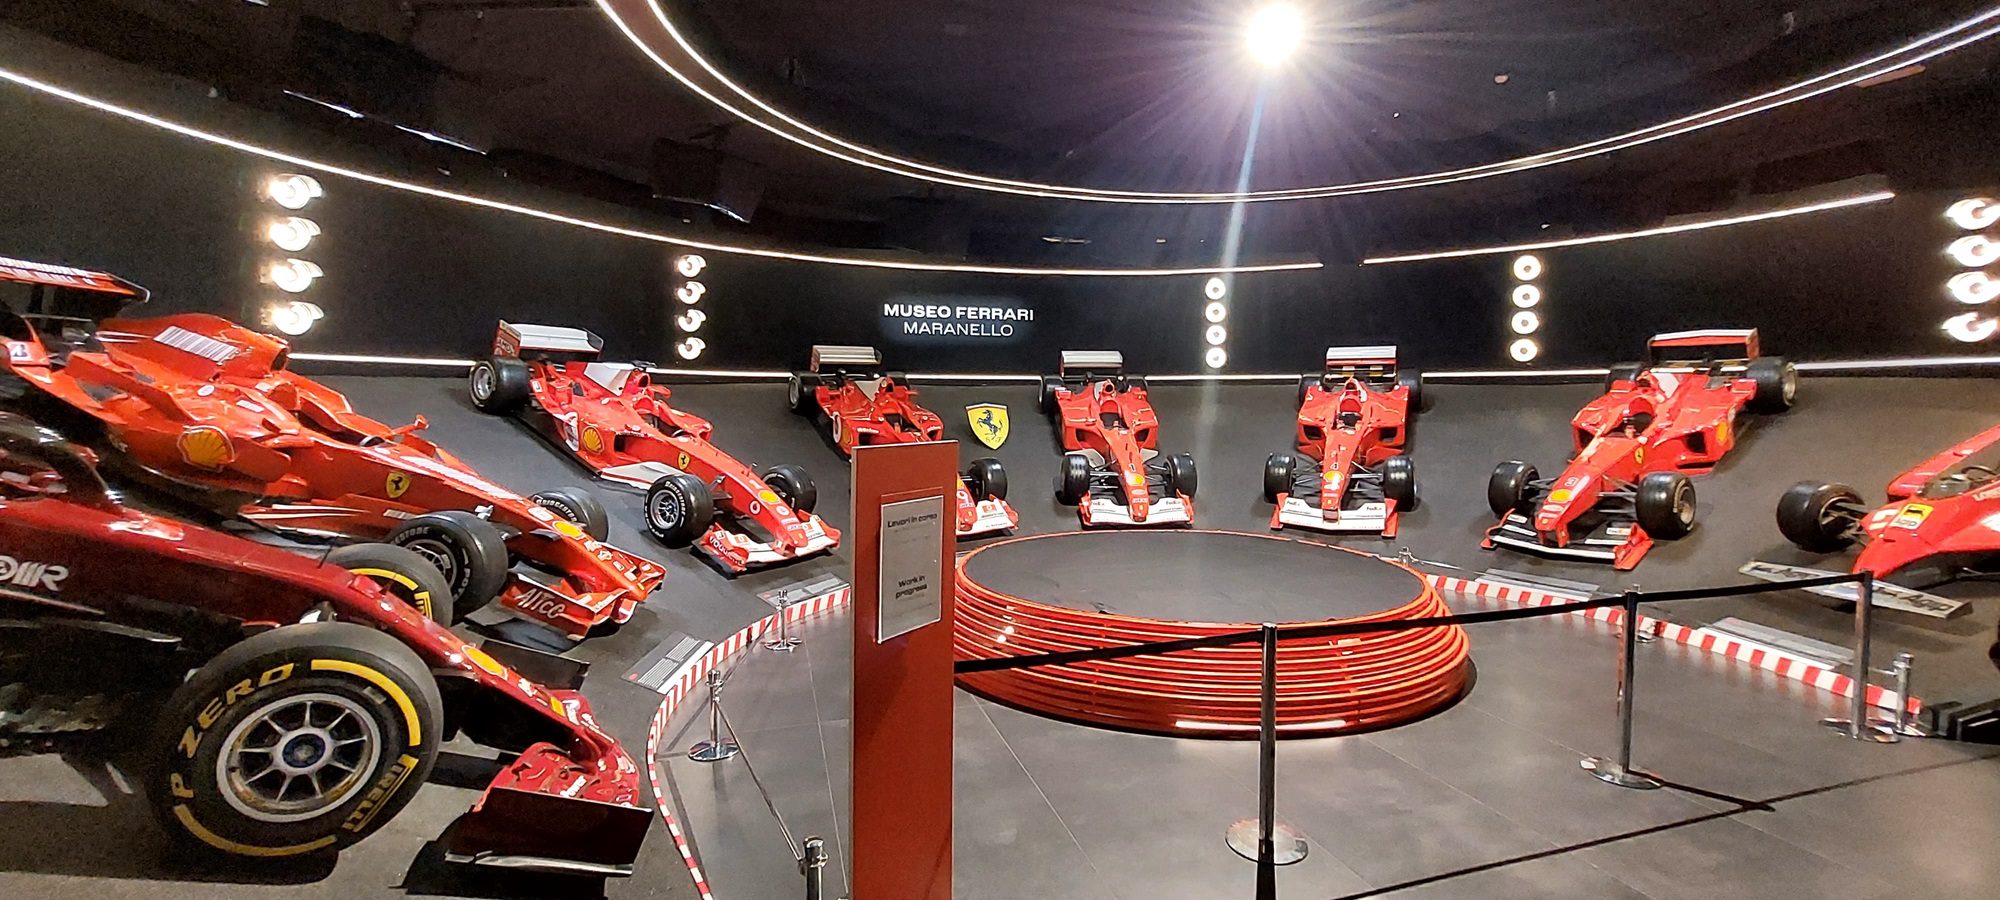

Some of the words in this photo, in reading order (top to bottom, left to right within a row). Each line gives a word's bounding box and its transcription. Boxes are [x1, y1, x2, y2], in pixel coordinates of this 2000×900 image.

[884, 303, 951, 318] MUSEO
[955, 306, 1034, 321] FERRARI
[903, 321, 1014, 337] MARANELLO
[532, 495, 578, 522] BRIDGESTO
[177, 662, 295, 759] ZERO
[341, 753, 420, 834] PIRELLI
